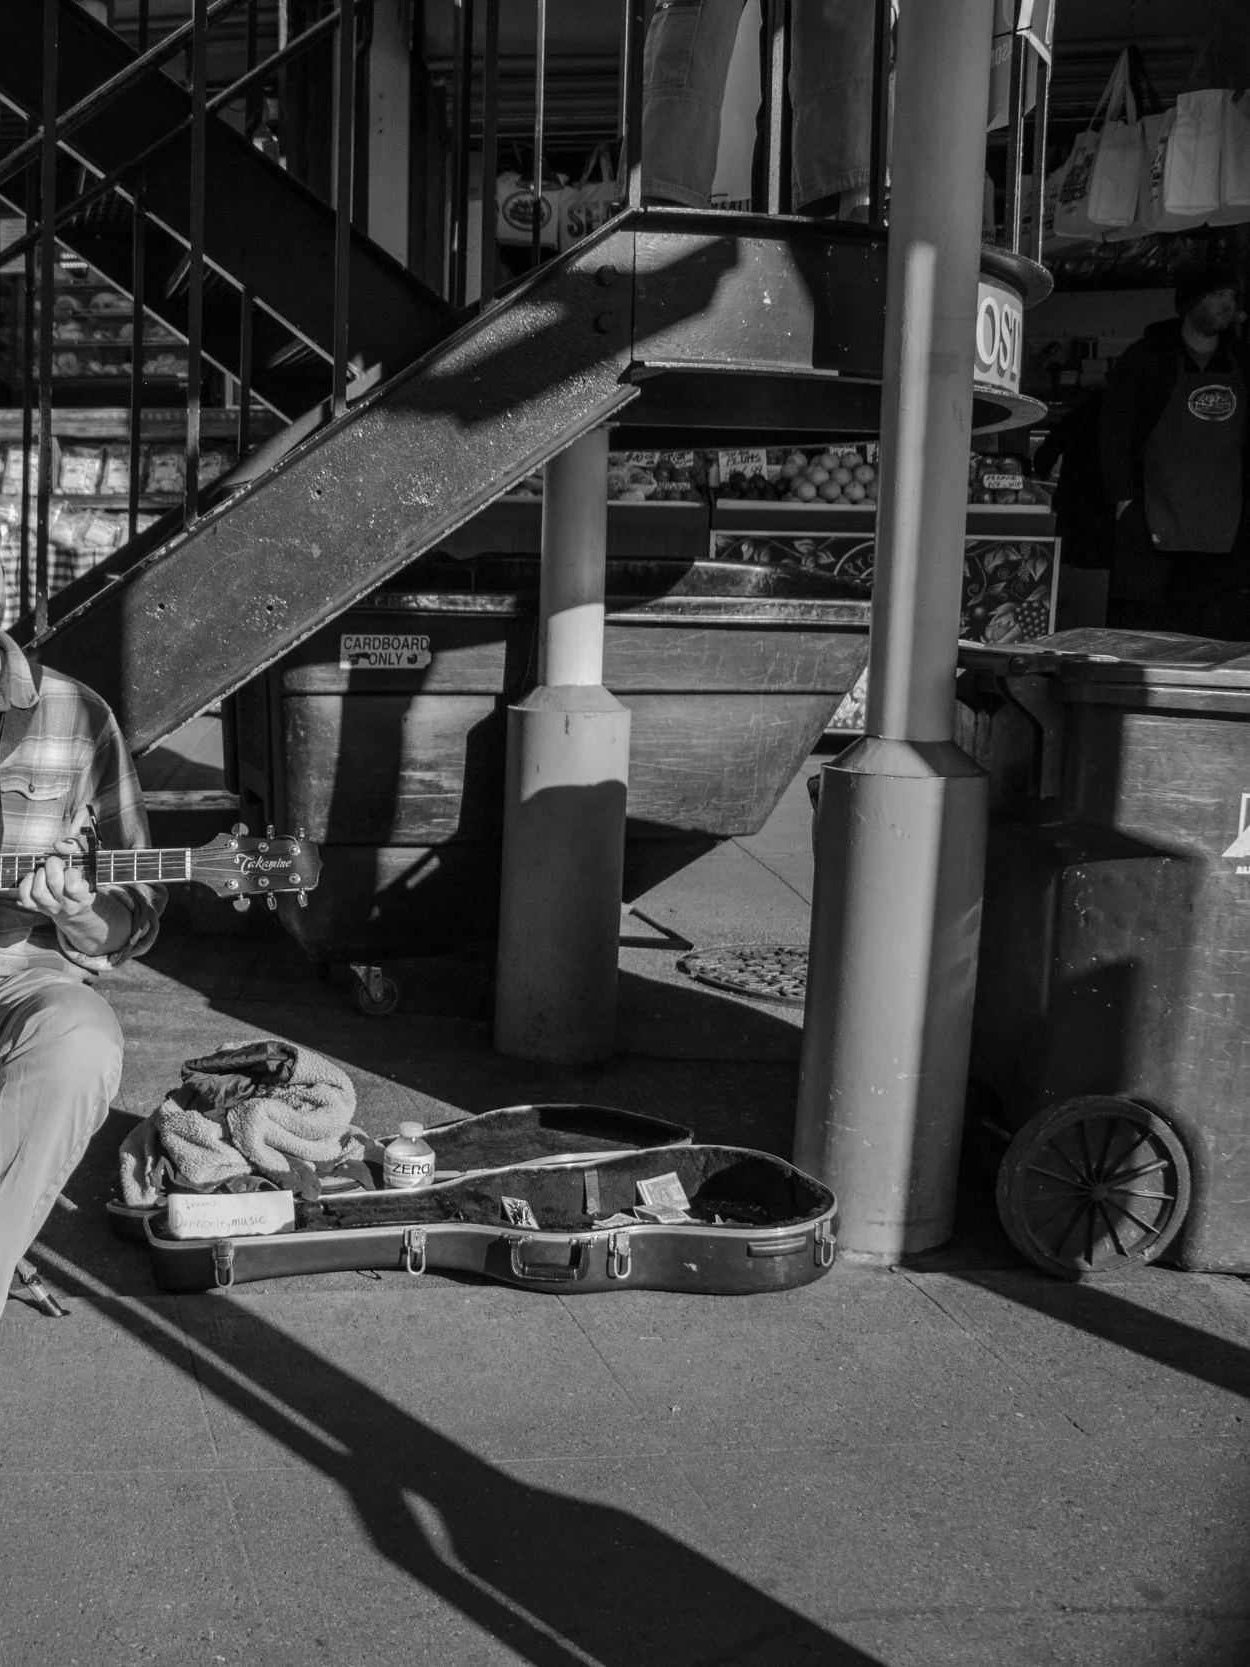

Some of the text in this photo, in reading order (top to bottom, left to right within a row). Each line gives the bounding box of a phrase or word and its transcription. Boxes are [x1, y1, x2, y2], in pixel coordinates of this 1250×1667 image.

[976, 296, 1021, 375] OST
[343, 636, 429, 650] CARDBOARD
[368, 652, 403, 666] ONLY
[233, 853, 293, 875] Takamine
[392, 1162, 430, 1175] ZERO
